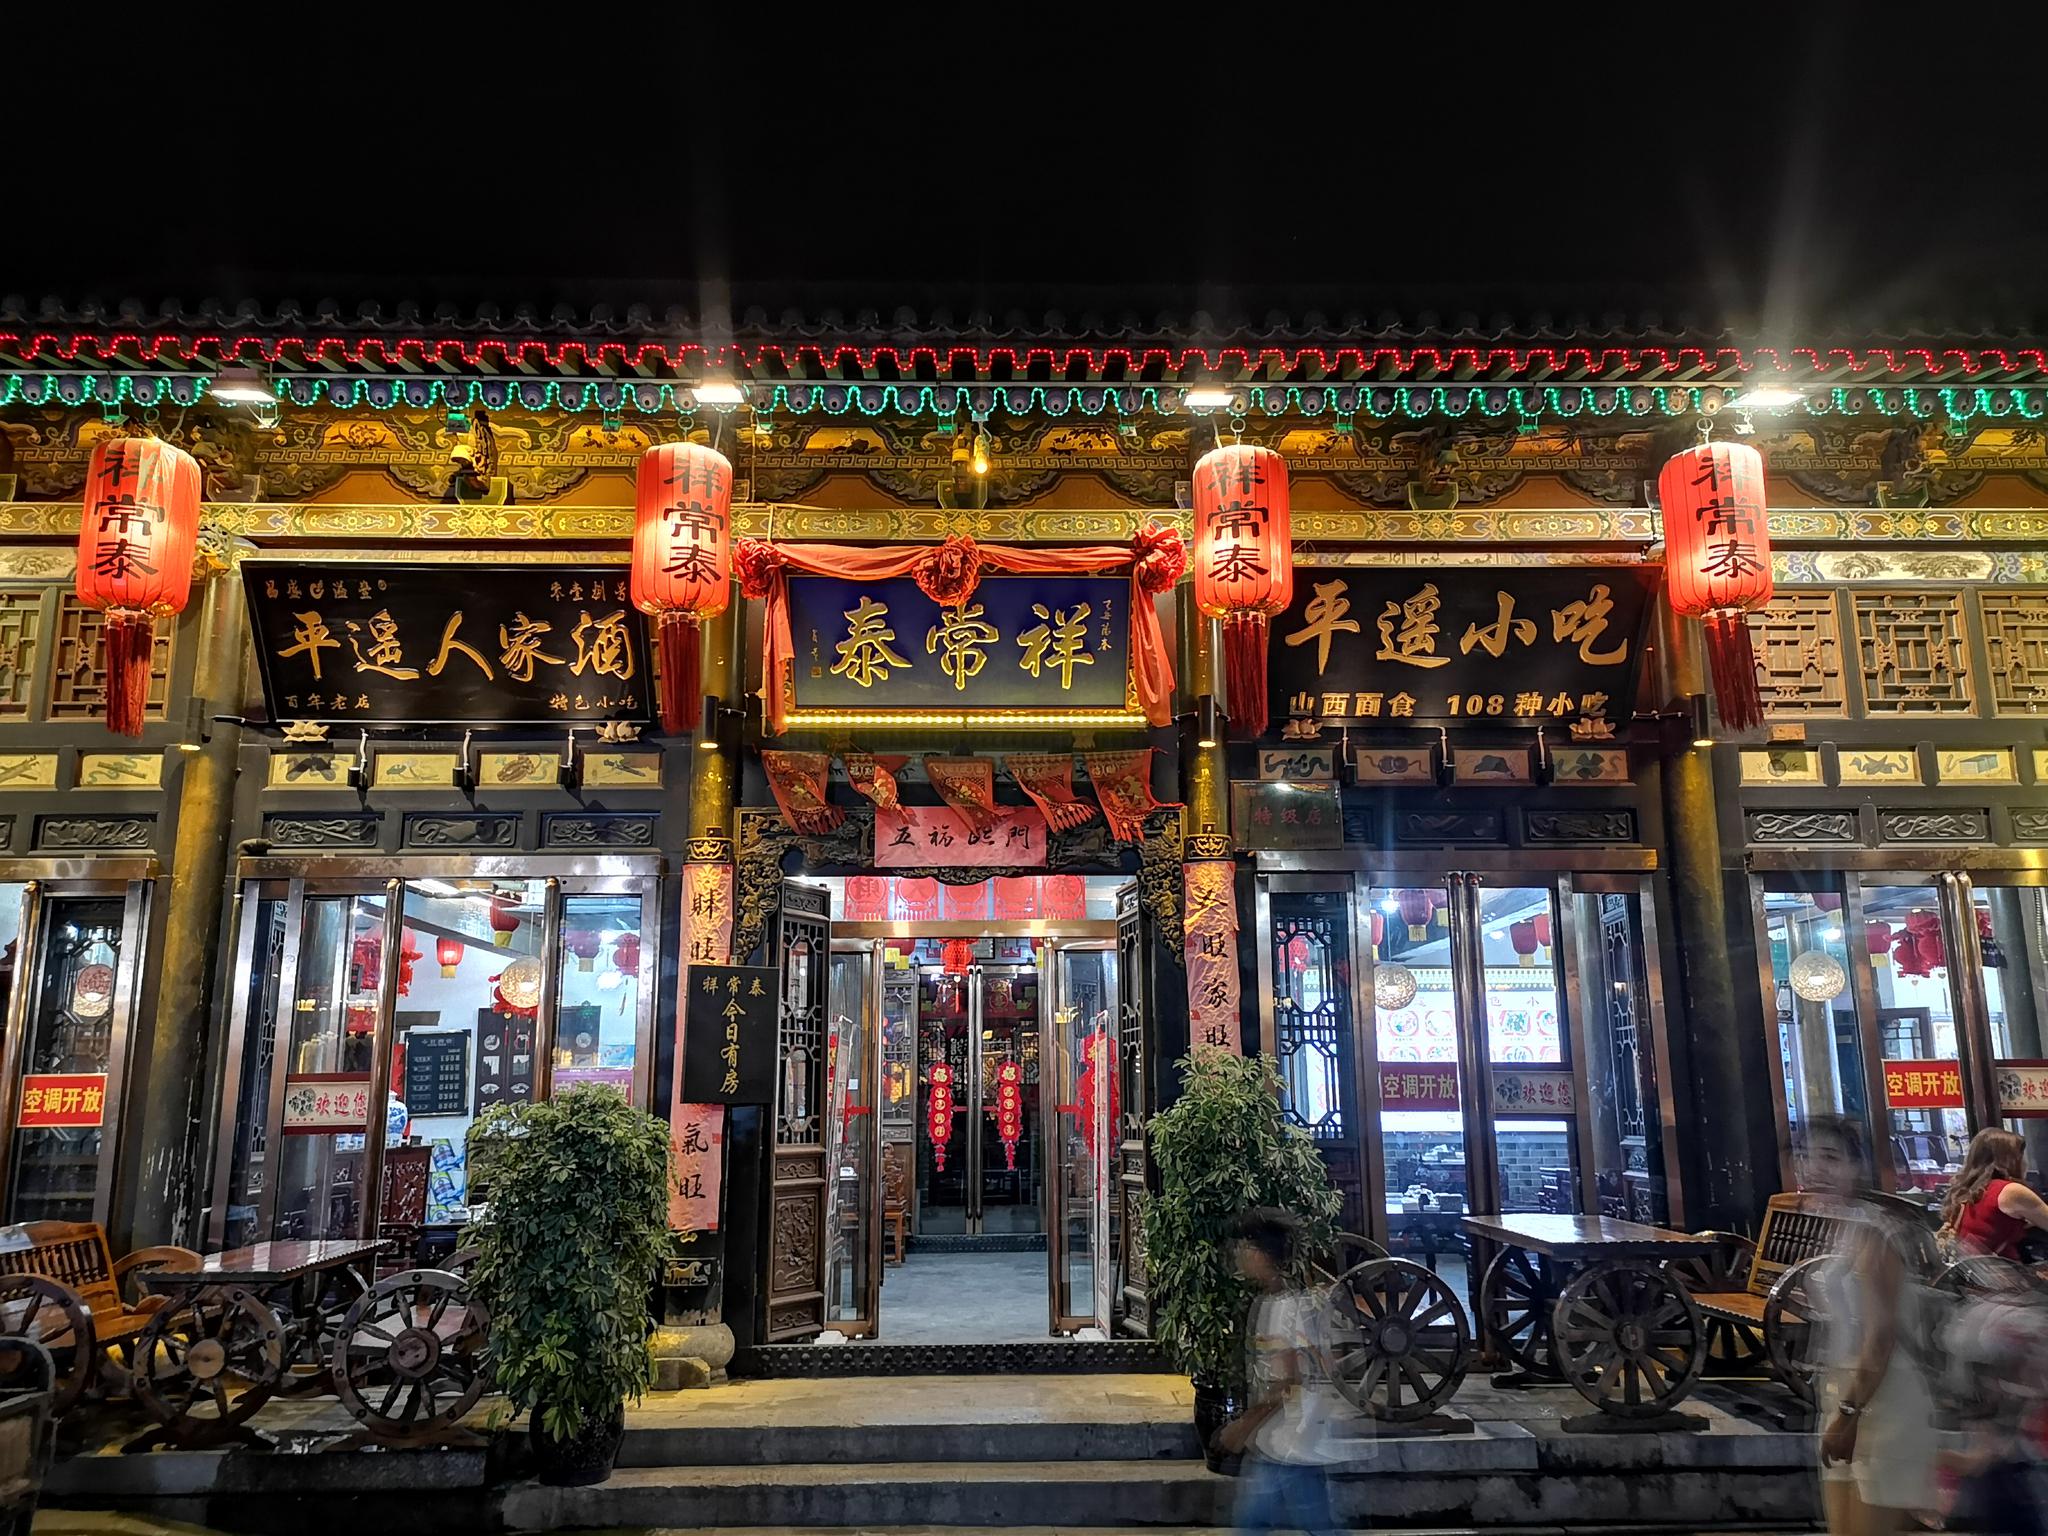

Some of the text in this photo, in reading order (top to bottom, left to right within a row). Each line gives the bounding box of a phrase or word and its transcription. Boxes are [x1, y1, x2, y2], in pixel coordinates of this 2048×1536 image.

[88, 450, 165, 579] 祥常泰
[662, 457, 724, 584] 祥常泰
[1207, 456, 1269, 583] 祥常泰
[1285, 578, 1628, 677] 平遥小吃
[284, 692, 371, 711] 百年老店
[548, 692, 638, 711] 特色小吃
[1289, 690, 1417, 717] 山西面食
[719, 998, 747, 1095] 今日有房
[1384, 1074, 1456, 1099] 空调开放
[1522, 1080, 1571, 1106] 欢迎您
[1887, 1071, 1960, 1097] 空调开放
[23, 1086, 102, 1114] 空调开放
[315, 1090, 367, 1118] 欢迎您
